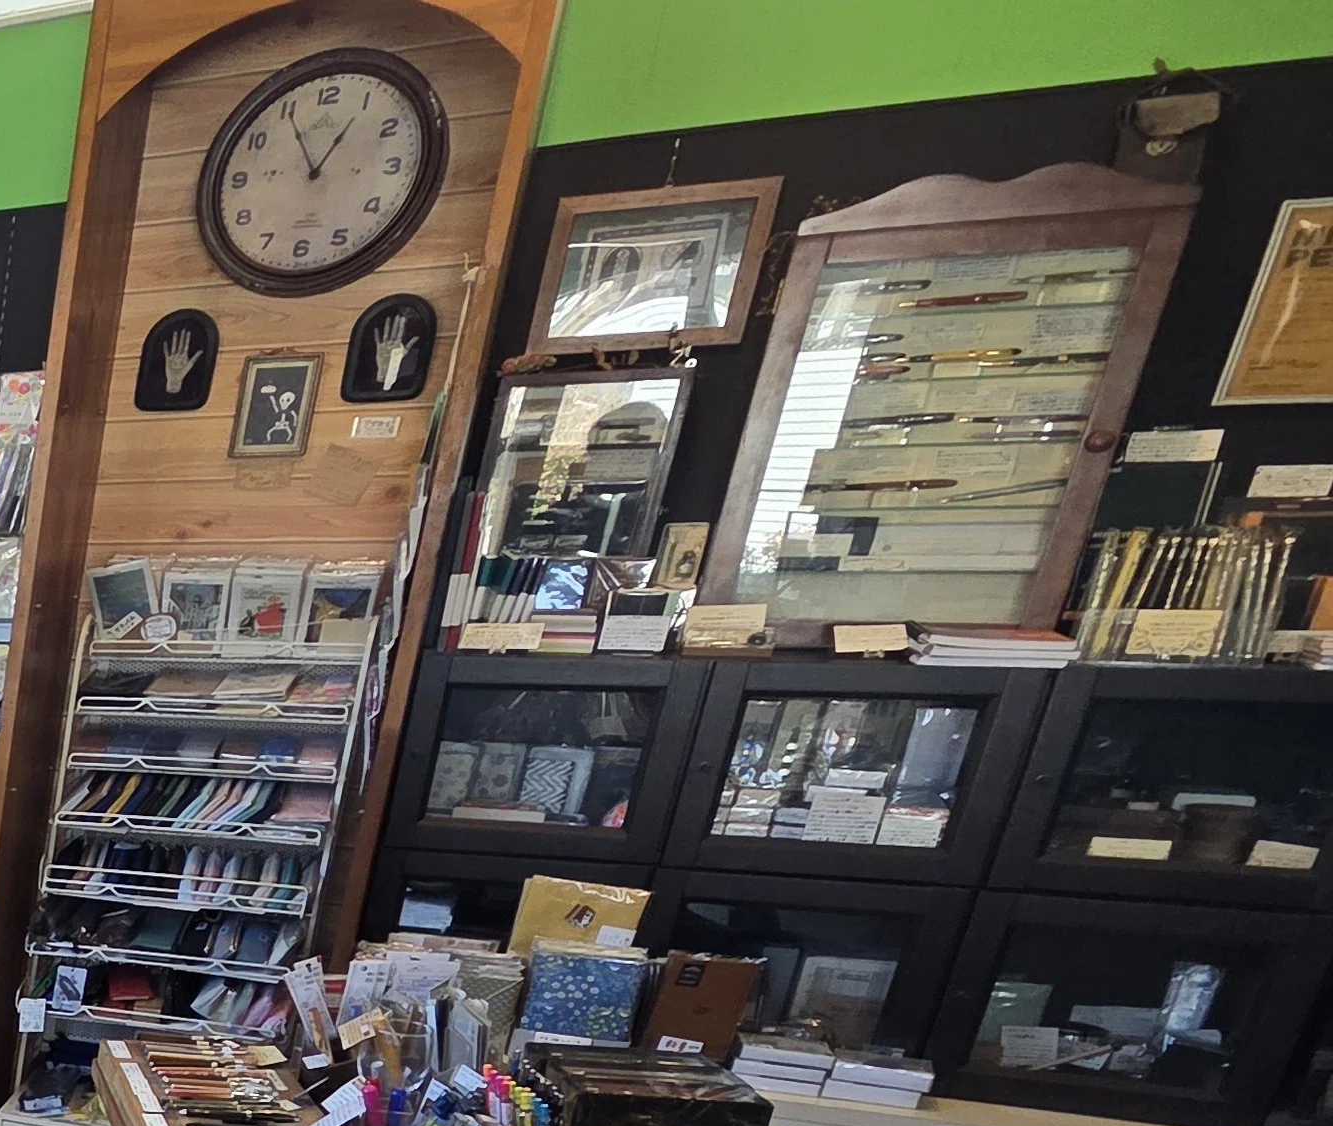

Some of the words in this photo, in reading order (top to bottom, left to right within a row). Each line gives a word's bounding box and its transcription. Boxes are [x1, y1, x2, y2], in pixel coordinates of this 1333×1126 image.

[317, 86, 341, 106] 12
[361, 91, 371, 111] 1
[280, 100, 297, 120] 11
[380, 118, 399, 137] 2
[247, 131, 267, 151] 10
[383, 157, 401, 175] 3
[231, 171, 248, 188] 9
[363, 196, 381, 215] 4
[235, 209, 251, 226] 8
[259, 232, 274, 250] 7
[330, 227, 348, 246] 5
[292, 239, 310, 258] 6
